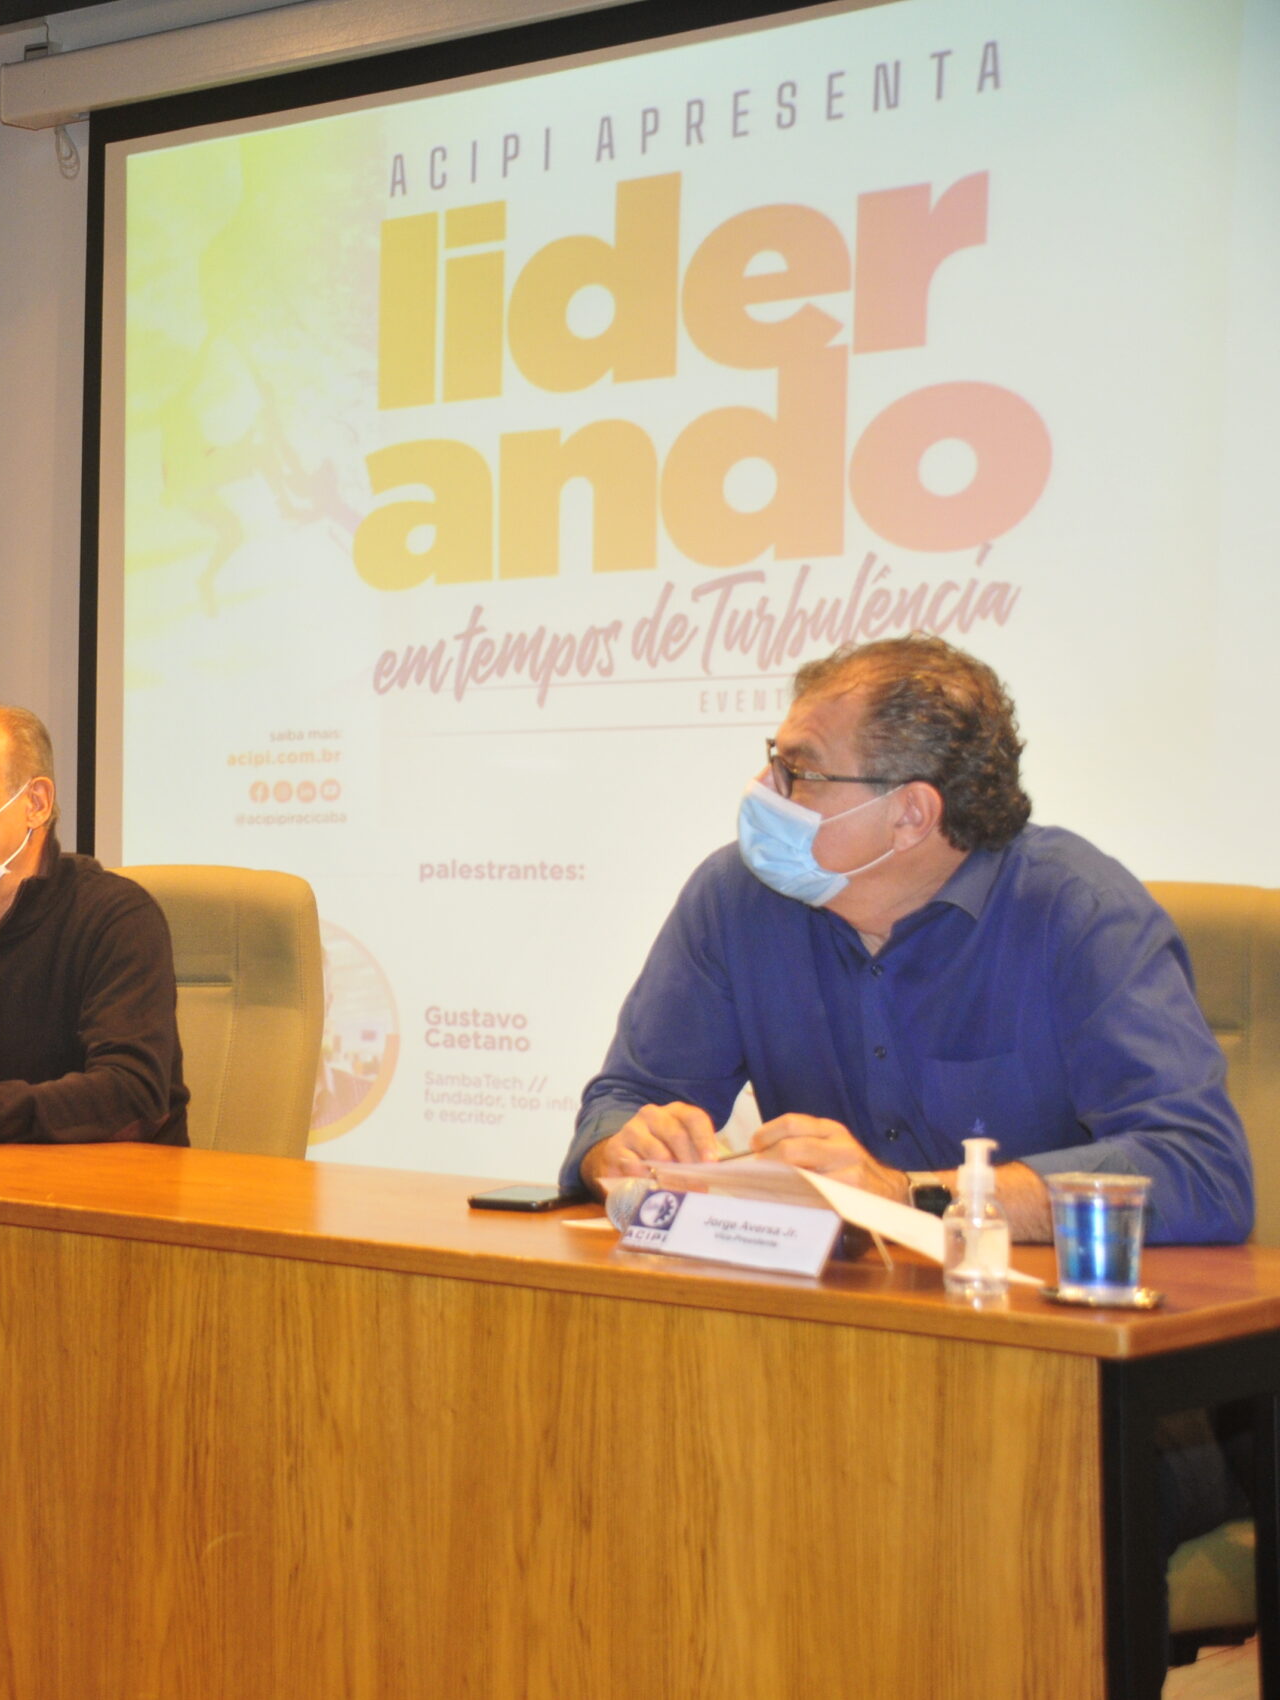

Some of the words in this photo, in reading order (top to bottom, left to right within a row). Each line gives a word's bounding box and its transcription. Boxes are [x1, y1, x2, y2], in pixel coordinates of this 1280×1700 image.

[389, 127, 551, 198] ACIPI
[596, 41, 1001, 163] APRESENTA
[378, 170, 989, 410] lider
[352, 343, 1052, 591] ando
[372, 643, 450, 696] em
[453, 603, 622, 708] tempos
[632, 581, 698, 669] de
[699, 687, 785, 713] EVENT
[227, 748, 342, 768] acipi.com.br
[419, 859, 586, 882] palestrantes:
[424, 1006, 529, 1030] Gustavo
[424, 1028, 531, 1052] Caetano
[424, 1071, 523, 1092] SambaTech
[424, 1090, 506, 1108] fundador,
[510, 1095, 541, 1111] top
[546, 1096, 580, 1111] infl
[424, 1109, 434, 1121] e
[439, 1109, 505, 1125] escritor
[703, 1216, 738, 1231] Jorge
[626, 1230, 668, 1243] ACIPI
